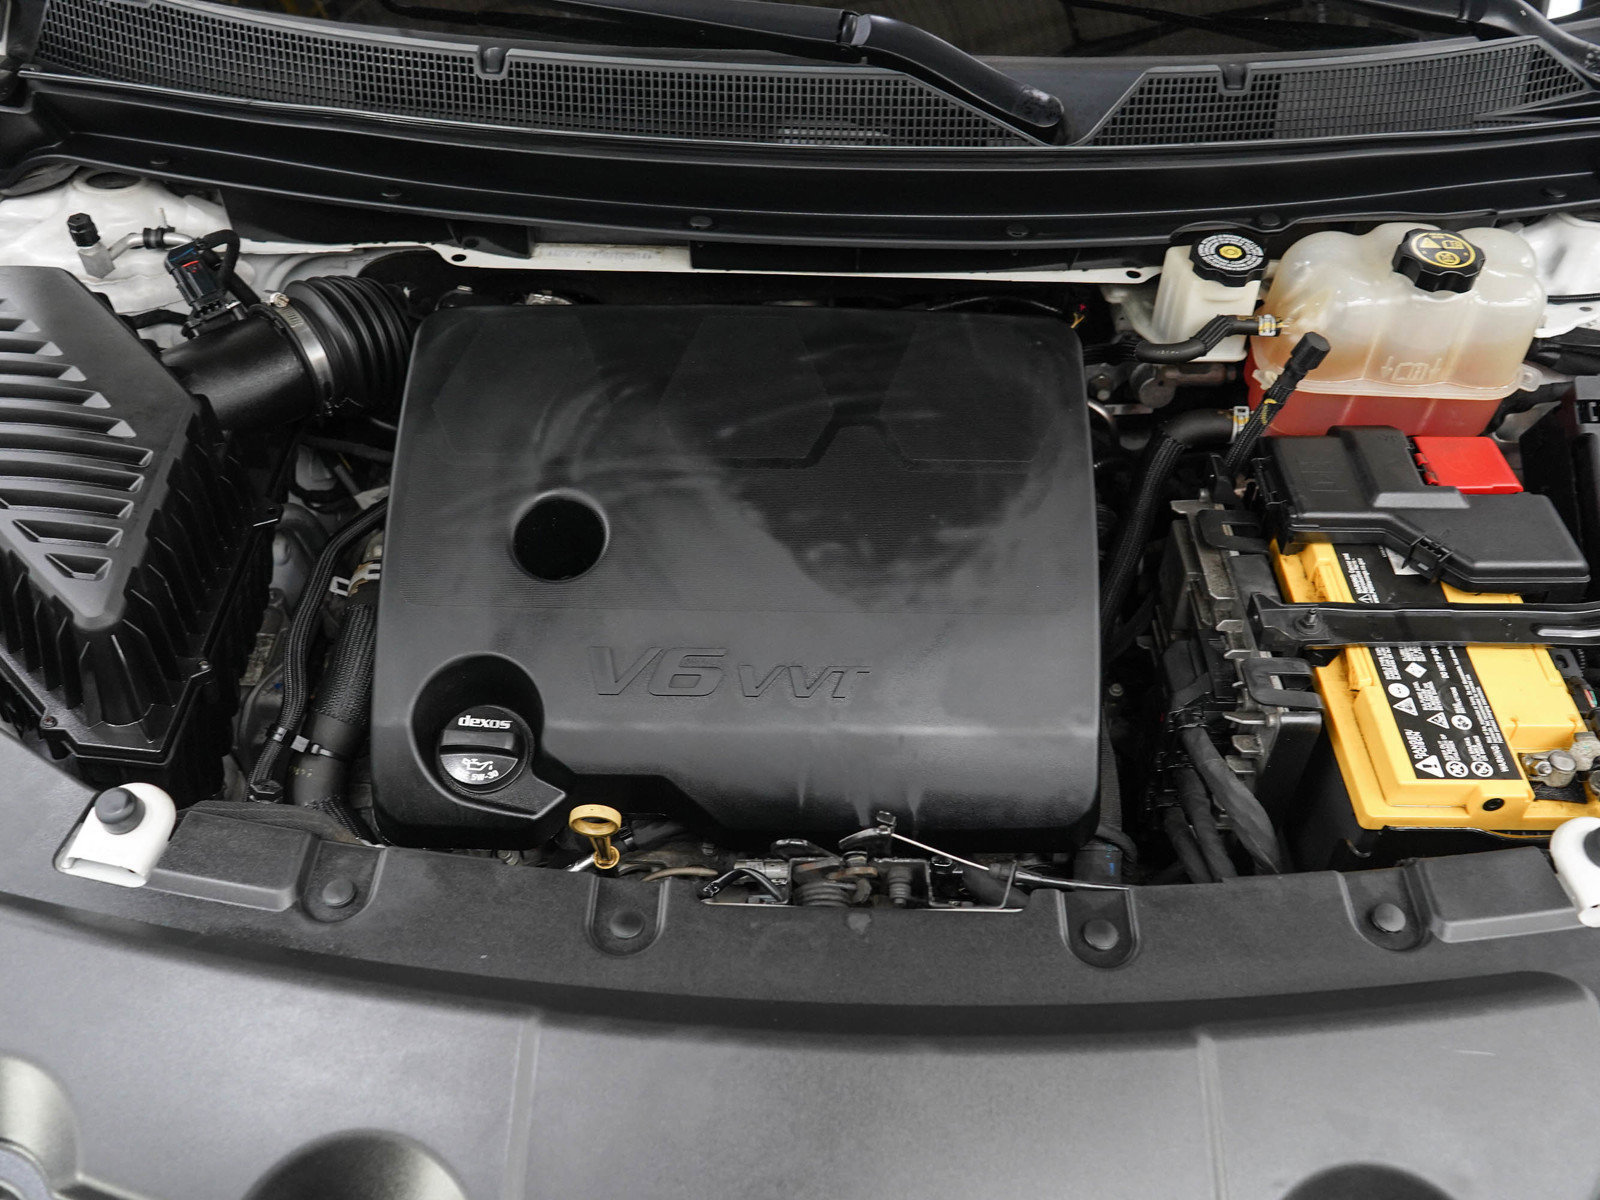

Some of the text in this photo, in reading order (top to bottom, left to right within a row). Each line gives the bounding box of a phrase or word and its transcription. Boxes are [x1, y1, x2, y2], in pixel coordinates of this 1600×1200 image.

[590, 645, 872, 699] V6 VVT
[458, 715, 513, 729] dexos
[471, 769, 499, 781] 5W-30
